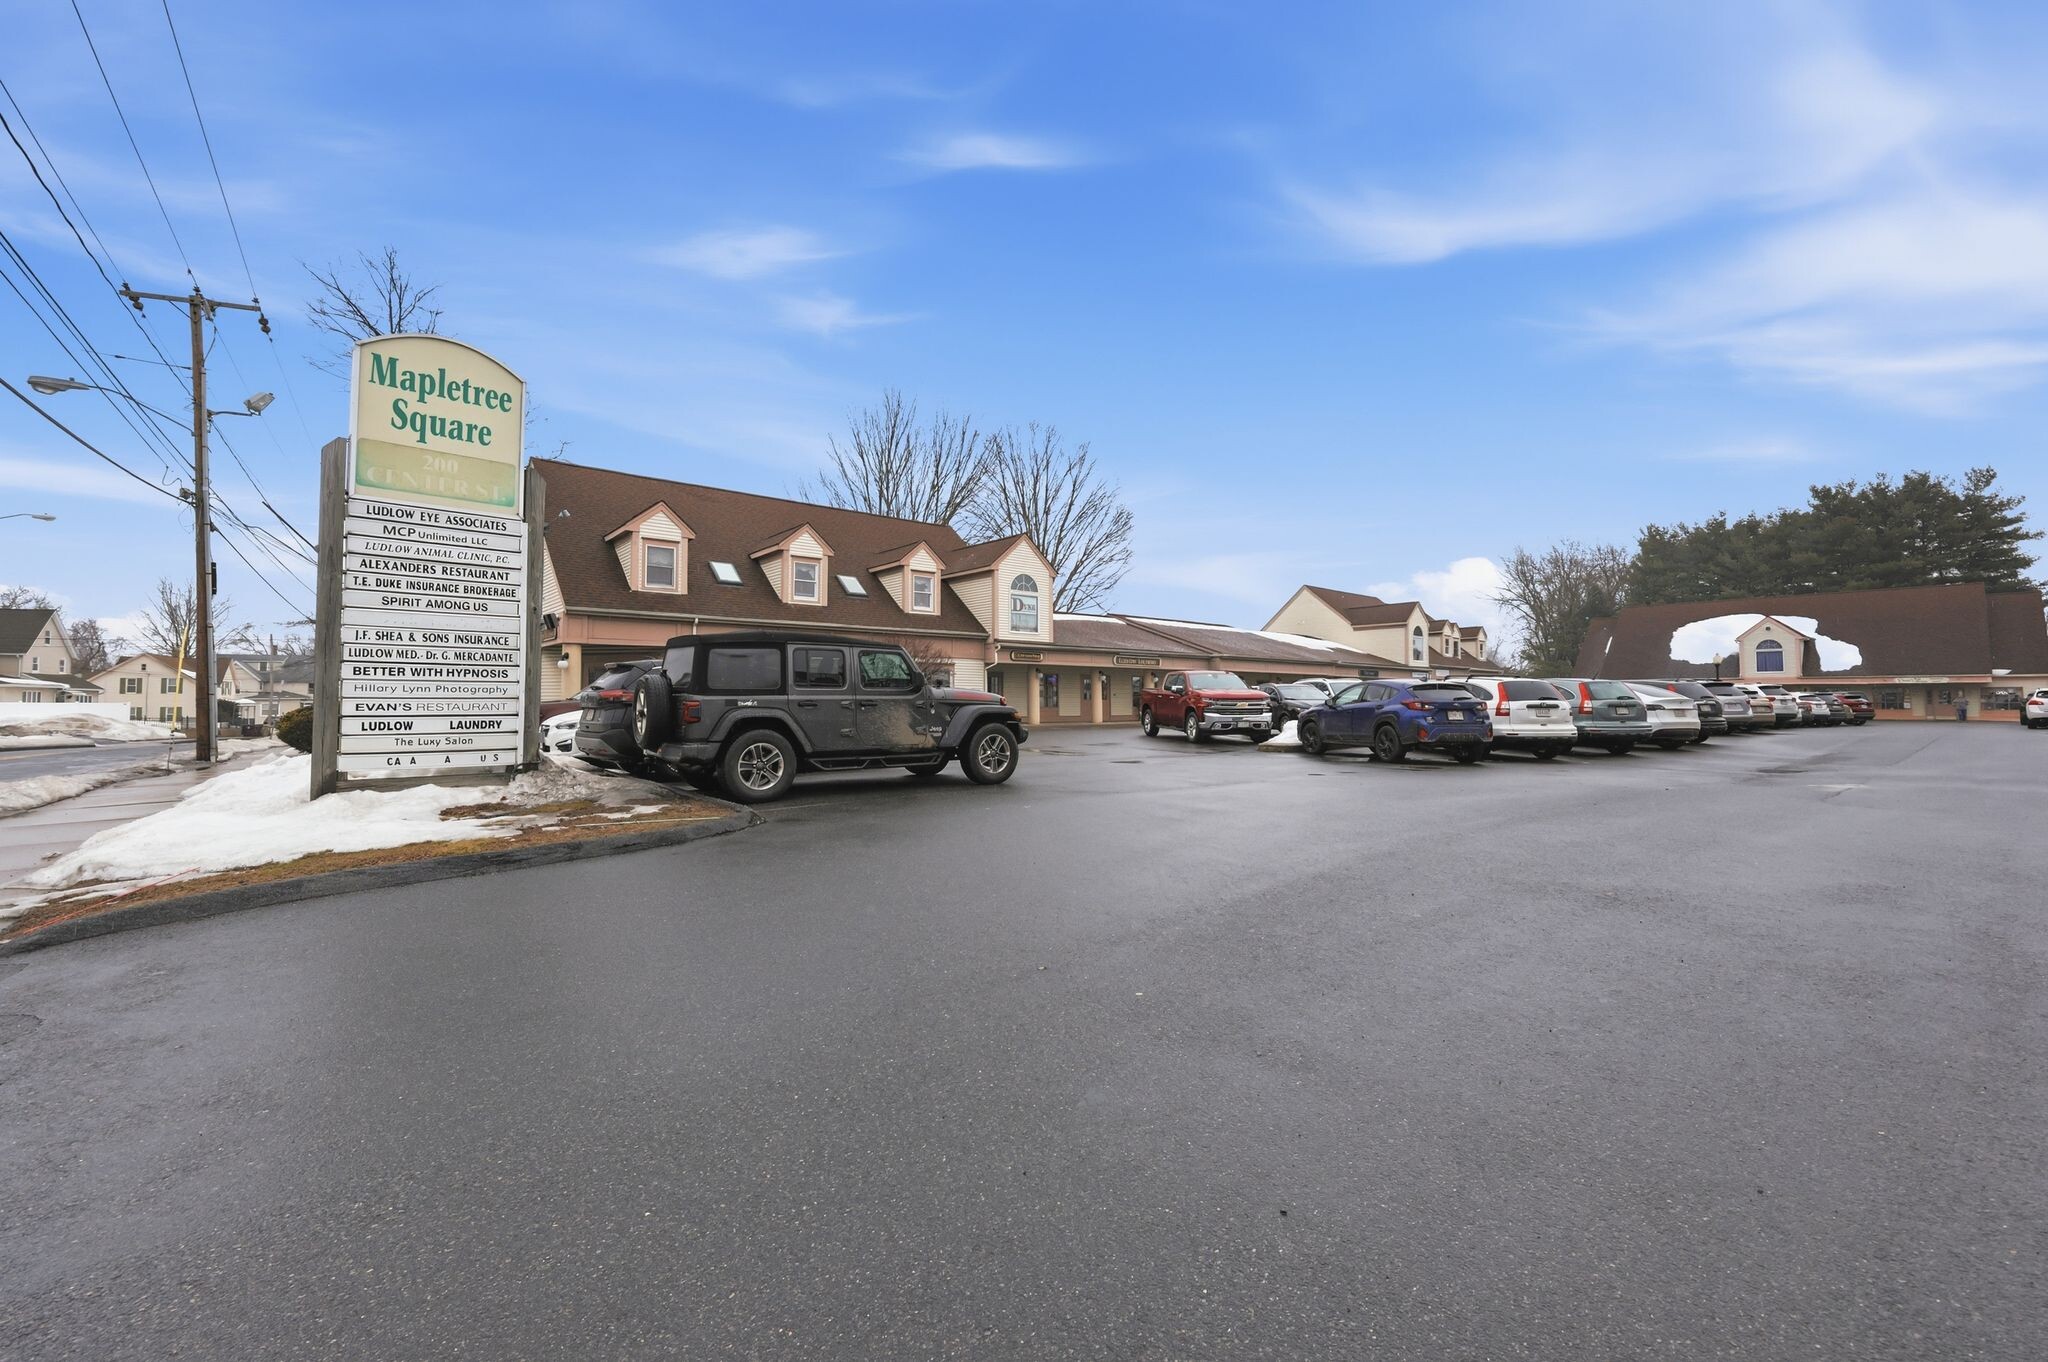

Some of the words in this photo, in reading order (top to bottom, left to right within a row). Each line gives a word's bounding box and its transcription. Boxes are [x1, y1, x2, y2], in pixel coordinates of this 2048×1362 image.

[368, 352, 512, 413] Mapletree
[390, 398, 492, 446] Square
[422, 454, 459, 475] 200
[366, 504, 416, 520] LUDLOW
[420, 511, 440, 523] EYE
[445, 515, 507, 532] ASSOCIATES
[382, 525, 416, 537] MCP
[418, 531, 468, 545] Unlimited
[471, 536, 488, 546] LLC
[365, 541, 413, 554] LUDLOW
[413, 547, 454, 559] ANIMAL
[457, 551, 493, 563] CLINIC,
[359, 558, 437, 575] ALEXANDERS
[441, 566, 511, 581] RESTAURANT
[353, 576, 371, 587] T.E.
[375, 577, 402, 589] DUKE
[406, 580, 460, 594] INSURANCE
[381, 596, 422, 607] SPIRIT
[425, 599, 470, 611] AMONG
[473, 602, 488, 612] US
[355, 629, 371, 641] J.F.
[375, 630, 403, 642] SHEA
[408, 632, 416, 642] &
[422, 633, 450, 643] SONS
[454, 634, 509, 646] INSURANCE
[348, 647, 394, 658] LUDLOW
[426, 650, 439, 660] Dr.
[441, 651, 451, 661] G.
[453, 652, 514, 663] MERCADANTE
[352, 666, 406, 676] BETTER
[410, 667, 443, 677] WITH
[446, 668, 509, 679] HYPNOSIS
[354, 683, 397, 694] Hillary
[402, 684, 431, 695] Lynn
[435, 685, 508, 695] Photography
[355, 703, 412, 712] EVAN'S
[416, 702, 508, 712] RESTAURANT
[361, 720, 414, 732] LUDLOW
[449, 719, 502, 730] LAUNDRY
[394, 737, 414, 747] The
[418, 737, 441, 747] Luxy
[445, 736, 473, 745] Salon
